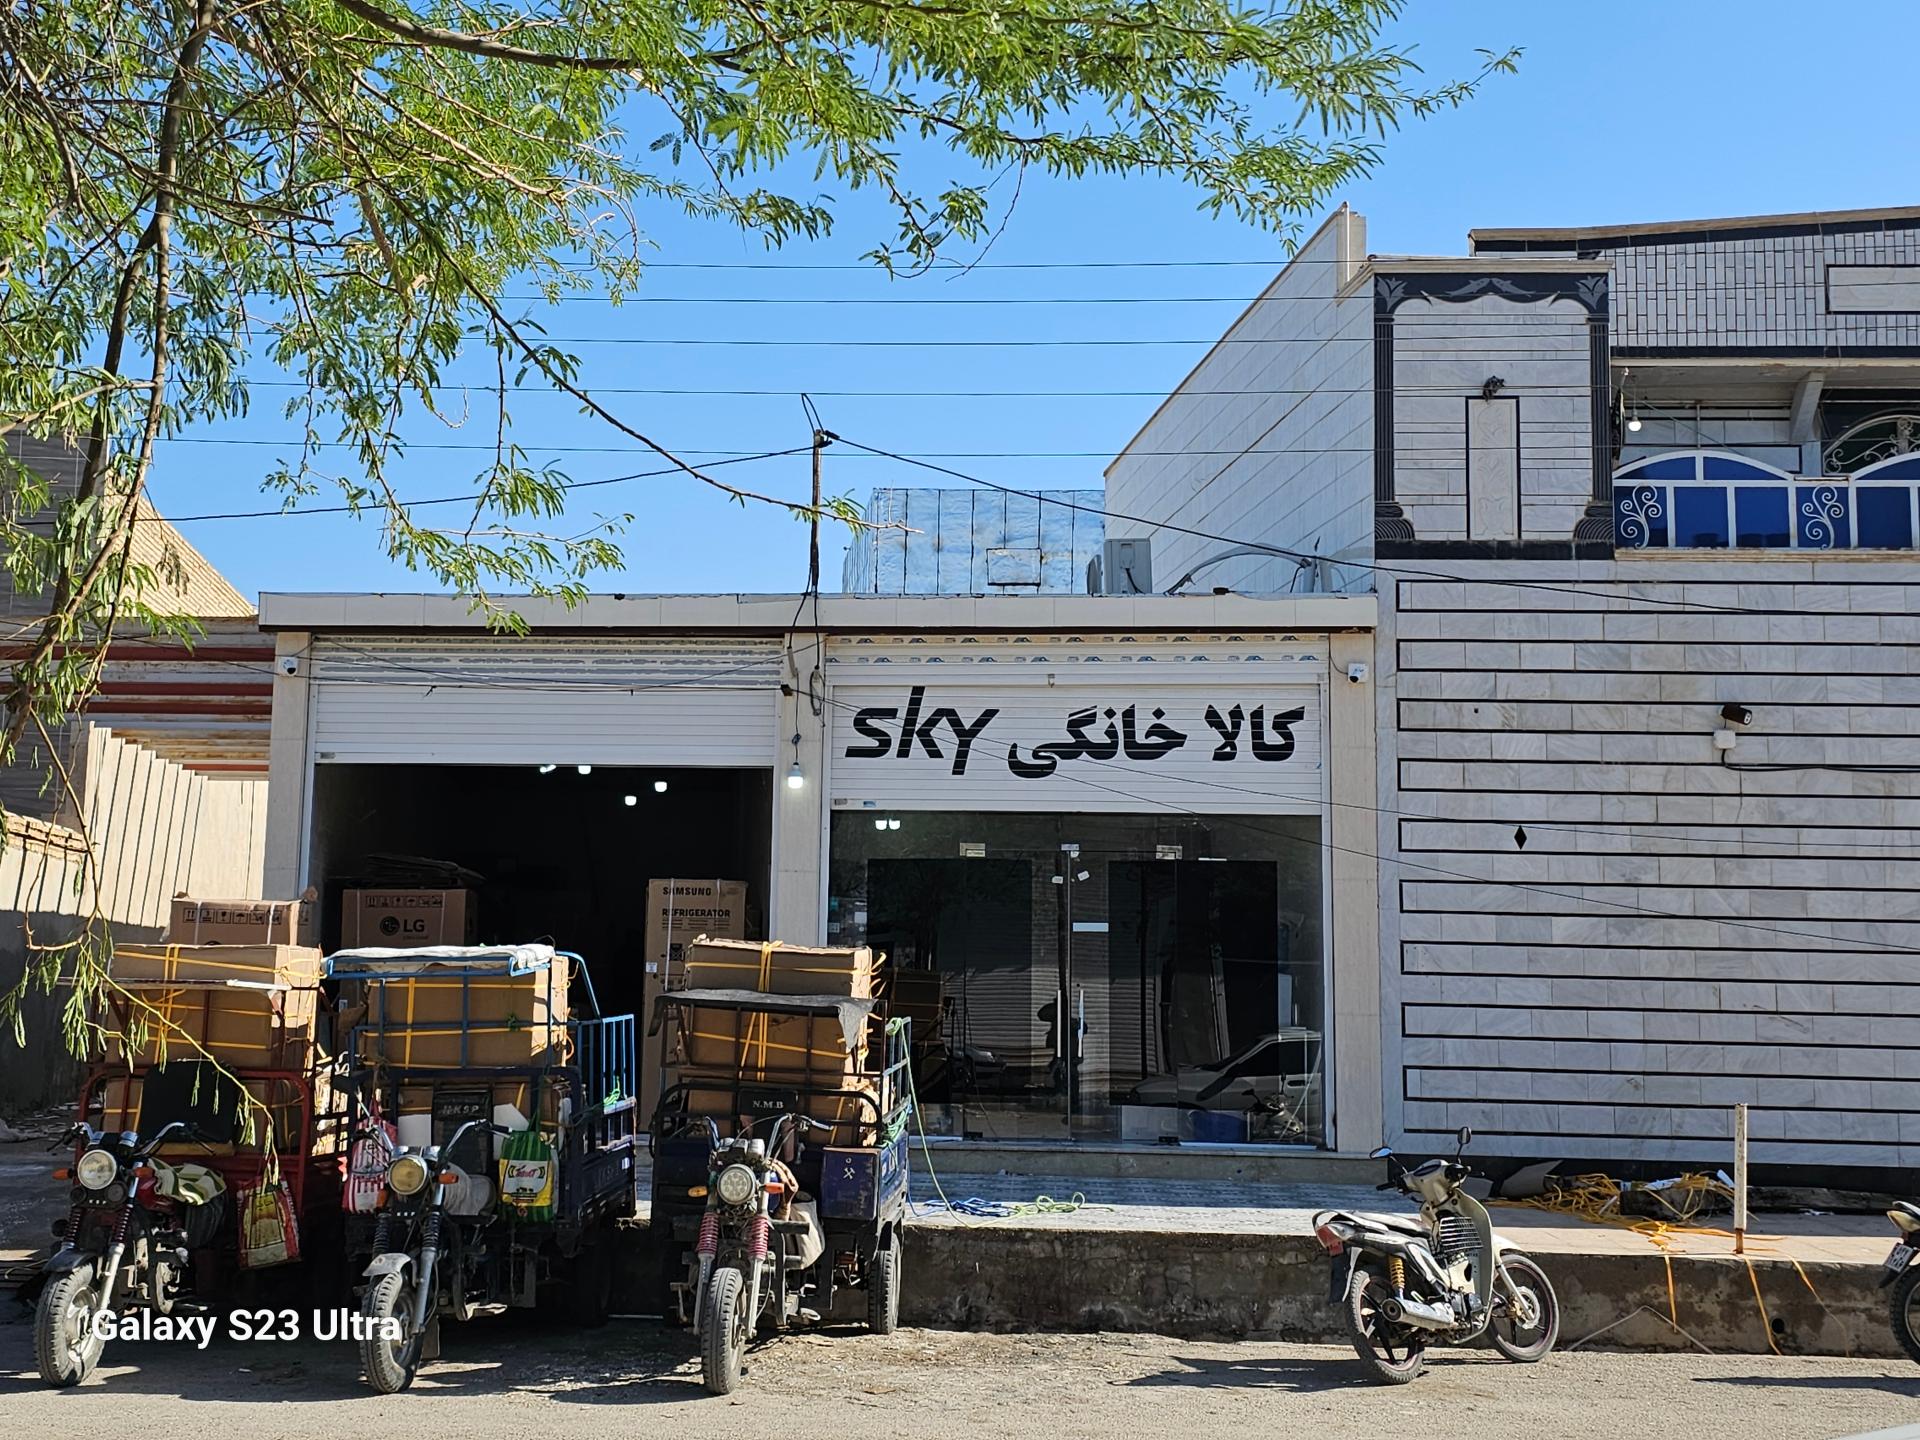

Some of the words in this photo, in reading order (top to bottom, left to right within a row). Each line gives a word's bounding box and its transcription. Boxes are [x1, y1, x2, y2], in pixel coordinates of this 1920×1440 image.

[1007, 703, 1188, 779] خانگی
[1204, 703, 1306, 762] کالا
[403, 919, 425, 933] LG
